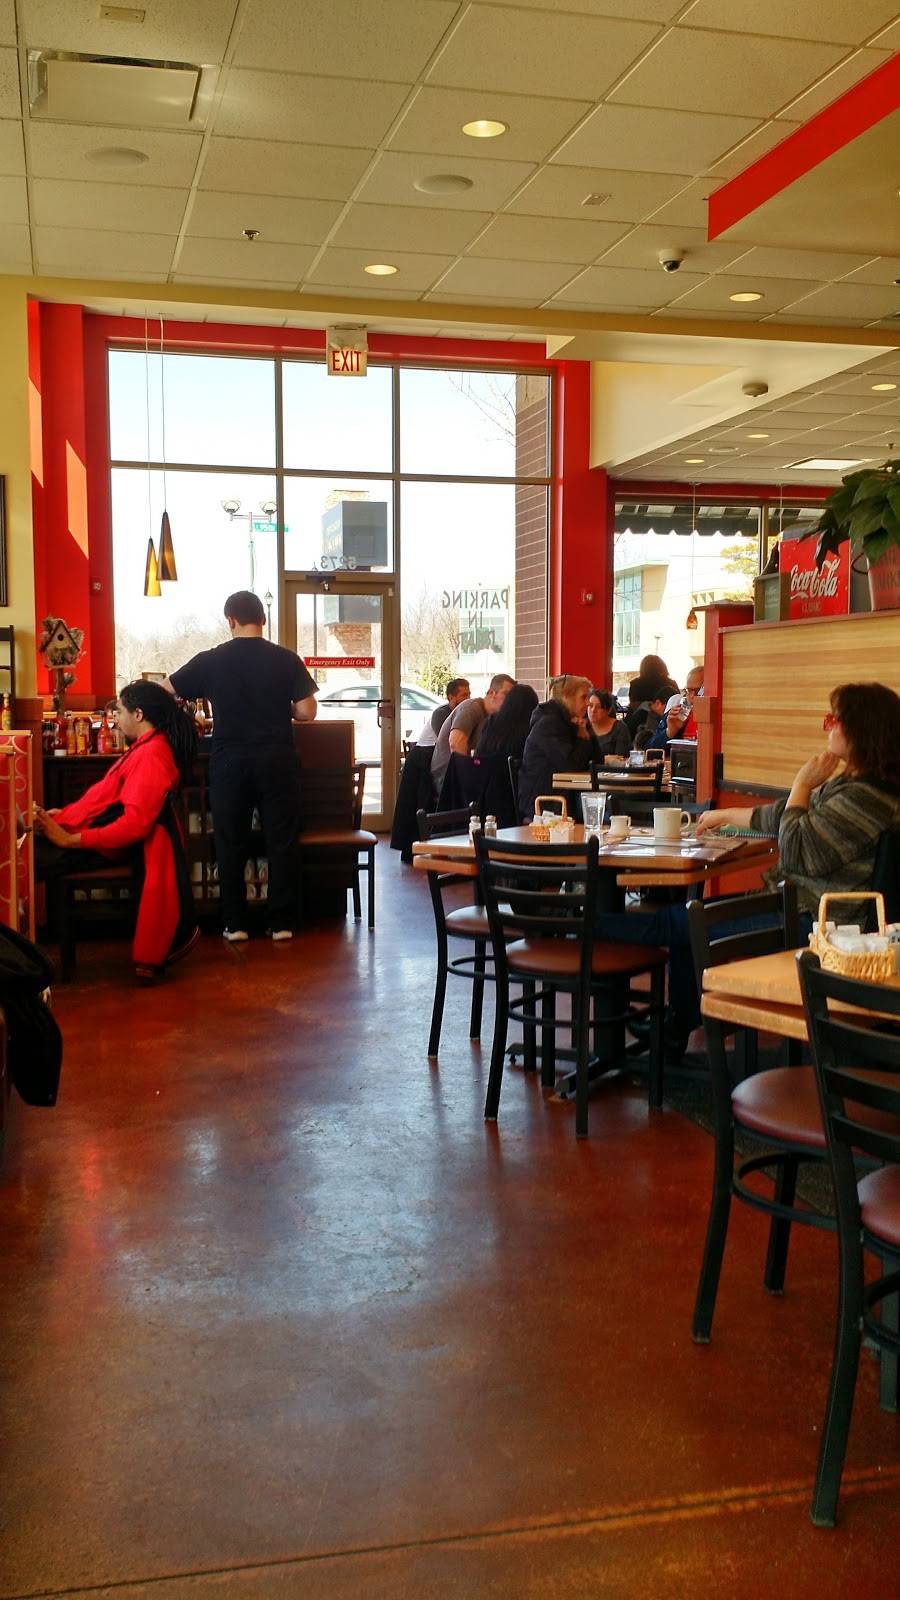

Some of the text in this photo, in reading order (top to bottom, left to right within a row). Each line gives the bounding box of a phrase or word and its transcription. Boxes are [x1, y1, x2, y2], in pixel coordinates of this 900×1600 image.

[332, 350, 361, 372] EXIT
[309, 658, 370, 668] Emergency Exit Only
